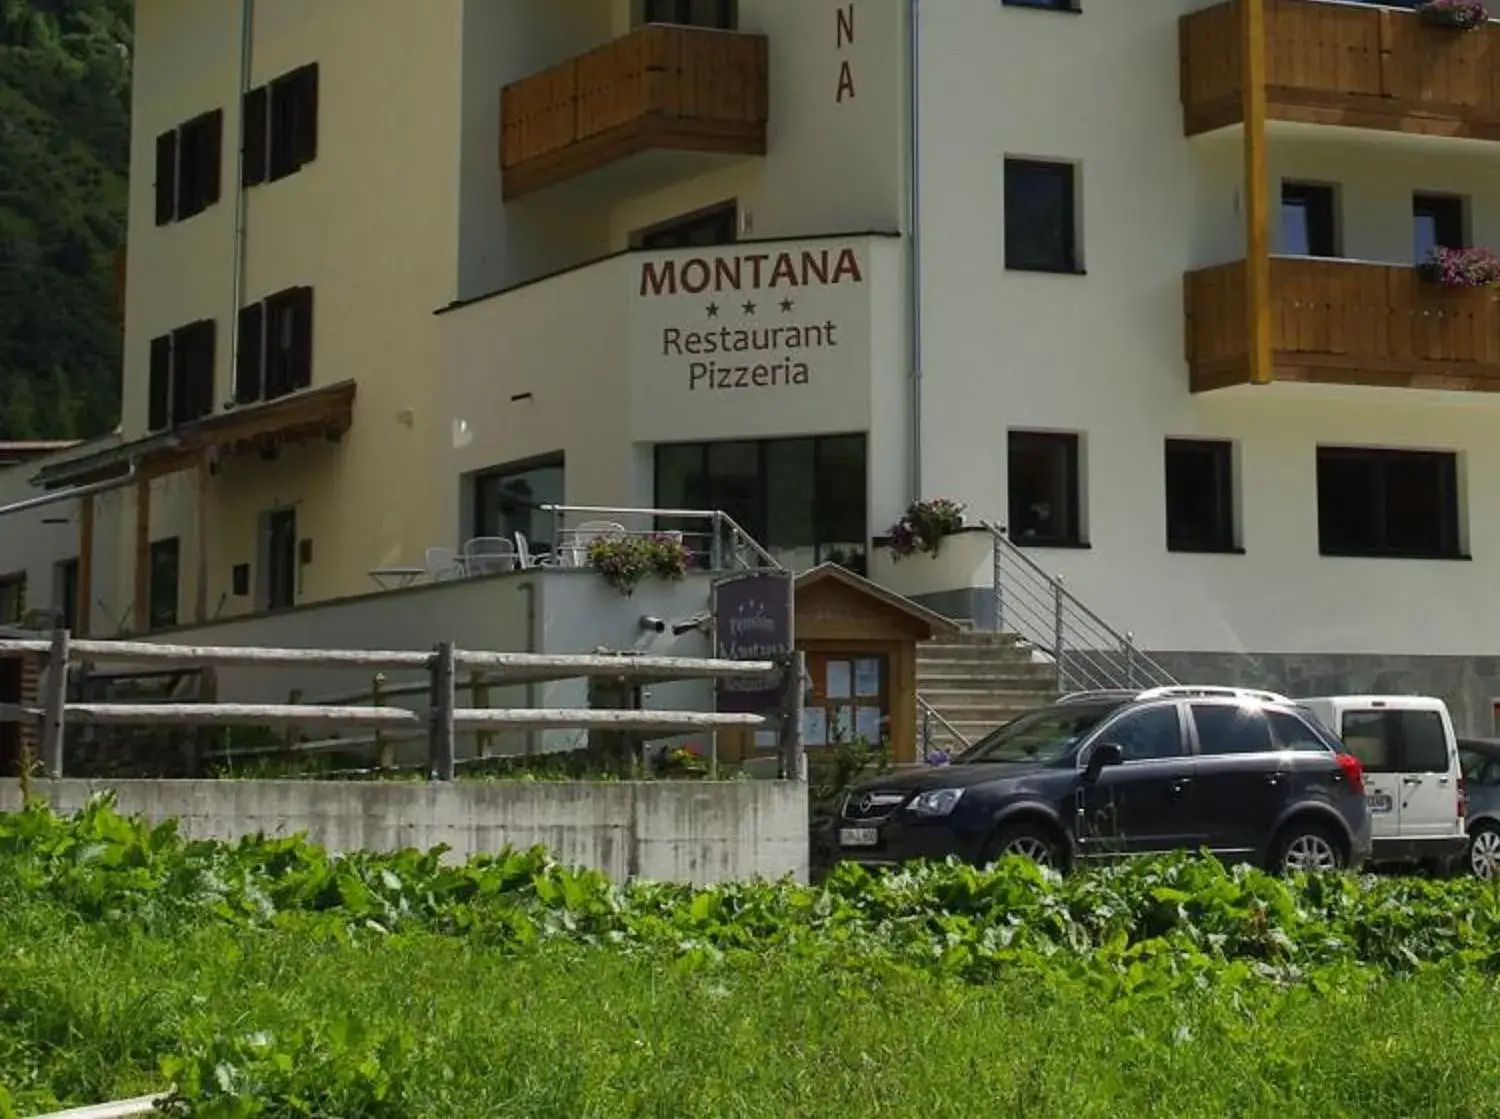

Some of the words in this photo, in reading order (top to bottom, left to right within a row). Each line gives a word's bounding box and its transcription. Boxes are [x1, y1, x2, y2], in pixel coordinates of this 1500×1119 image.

[639, 248, 863, 296] MONTANA
[662, 320, 837, 356] Restaurant
[689, 356, 810, 390] Pizzeria
